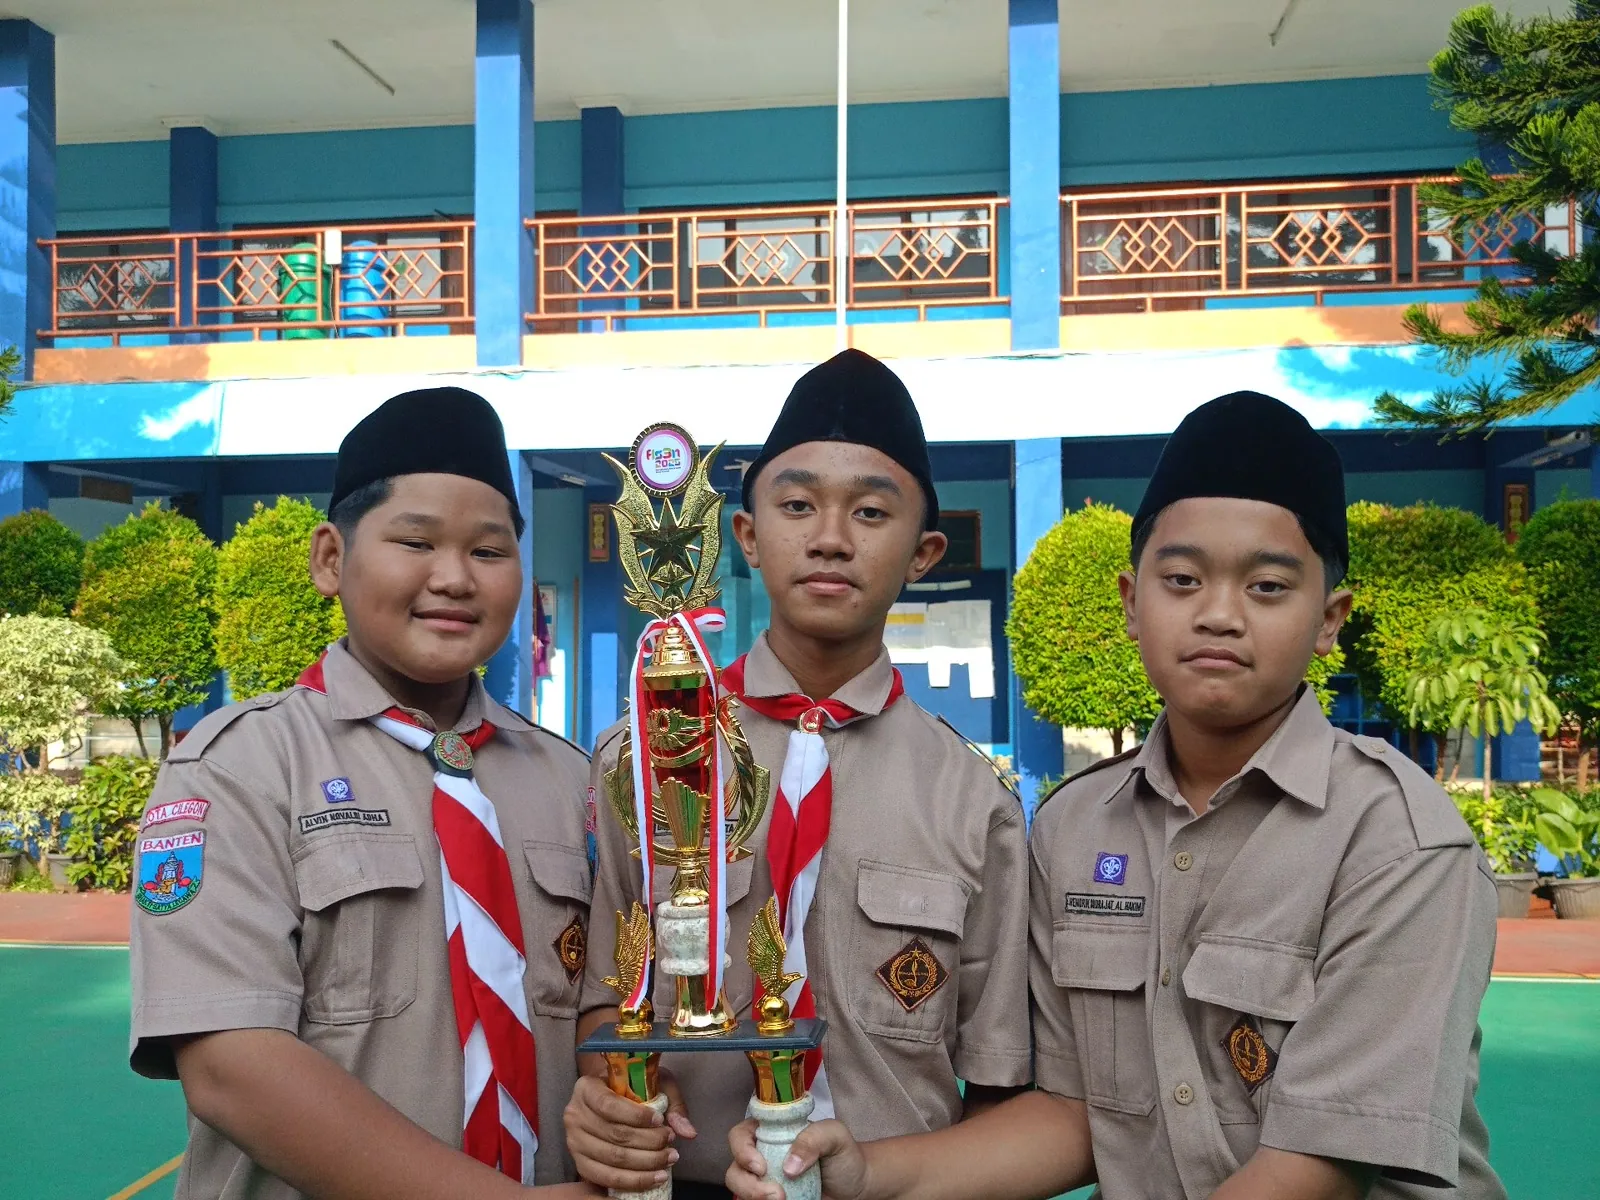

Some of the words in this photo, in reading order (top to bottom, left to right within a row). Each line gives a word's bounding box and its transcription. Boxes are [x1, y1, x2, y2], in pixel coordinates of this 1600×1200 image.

[655, 458, 681, 468] 2025
[145, 808, 166, 822] OTA
[172, 802, 204, 816] CILEGON
[305, 814, 329, 829] ALVIN
[362, 813, 384, 822] ADHA
[142, 831, 202, 850] BANTEN
